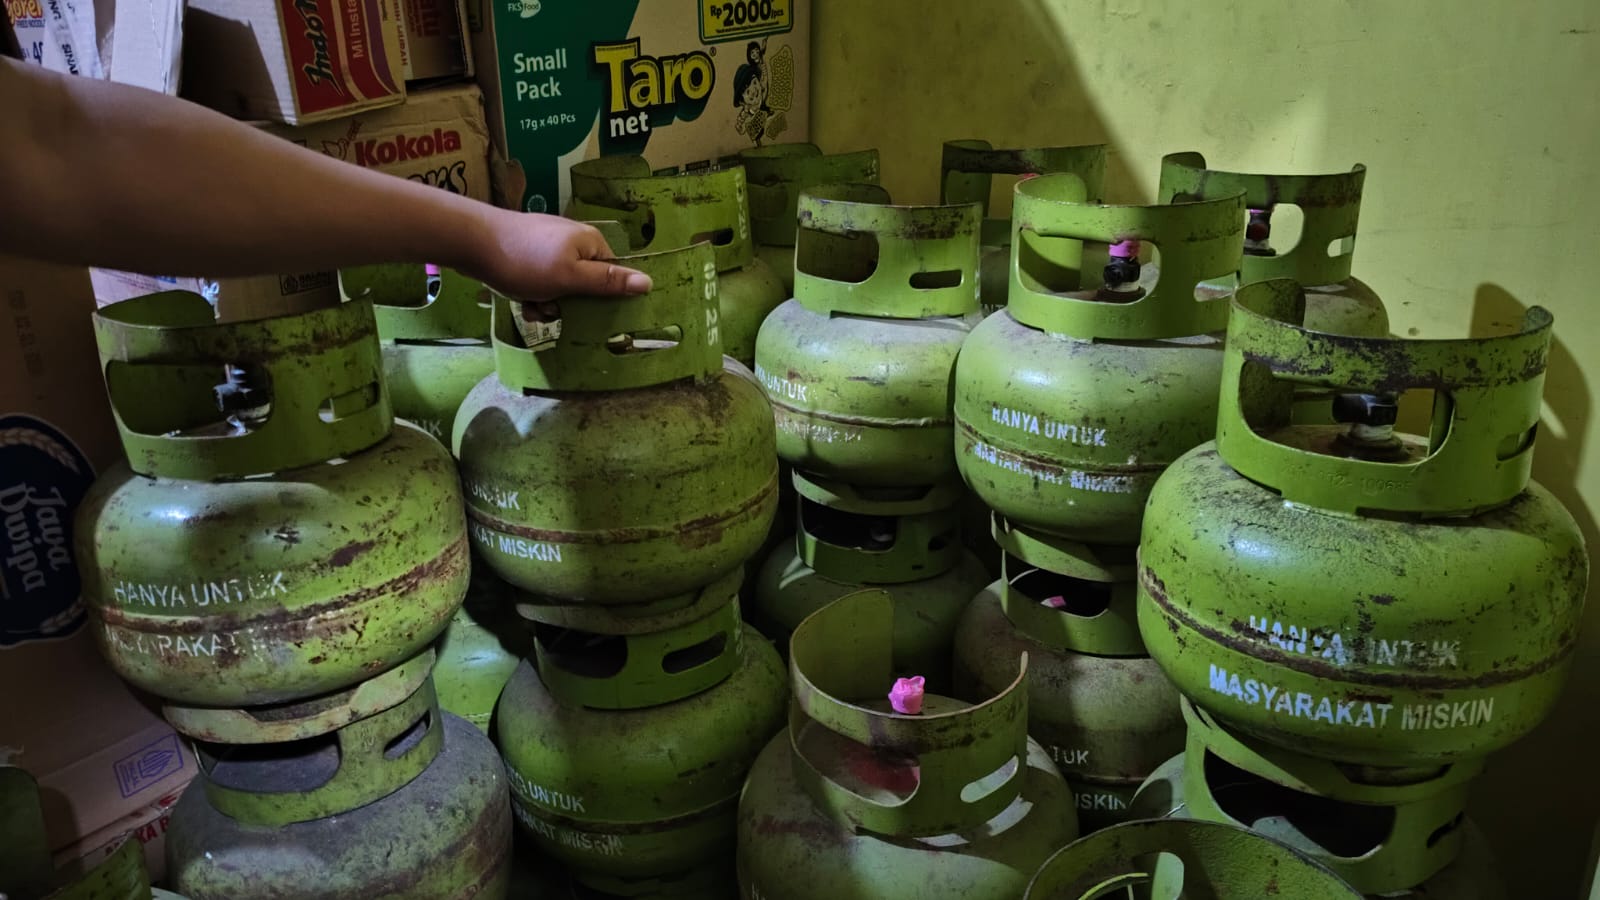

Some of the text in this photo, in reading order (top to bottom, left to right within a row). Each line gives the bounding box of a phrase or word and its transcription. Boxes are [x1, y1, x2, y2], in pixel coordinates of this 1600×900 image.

[710, 5, 722, 19] Rp
[723, 0, 771, 26] 2000
[513, 48, 567, 74] Small
[516, 76, 562, 102] Pack
[594, 40, 714, 113] Taro
[520, 118, 538, 131] 17g
[547, 115, 558, 126] 40
[560, 113, 576, 124] Pcs
[610, 111, 649, 138] net
[354, 128, 462, 167] Kokola
[991, 406, 1108, 448] HANYA UNTUK
[498, 536, 562, 563] MISKIN
[114, 581, 188, 607] HANYA
[1209, 663, 1494, 731] MASYARAKAT MISKIN
[528, 781, 586, 814] UNTUK
